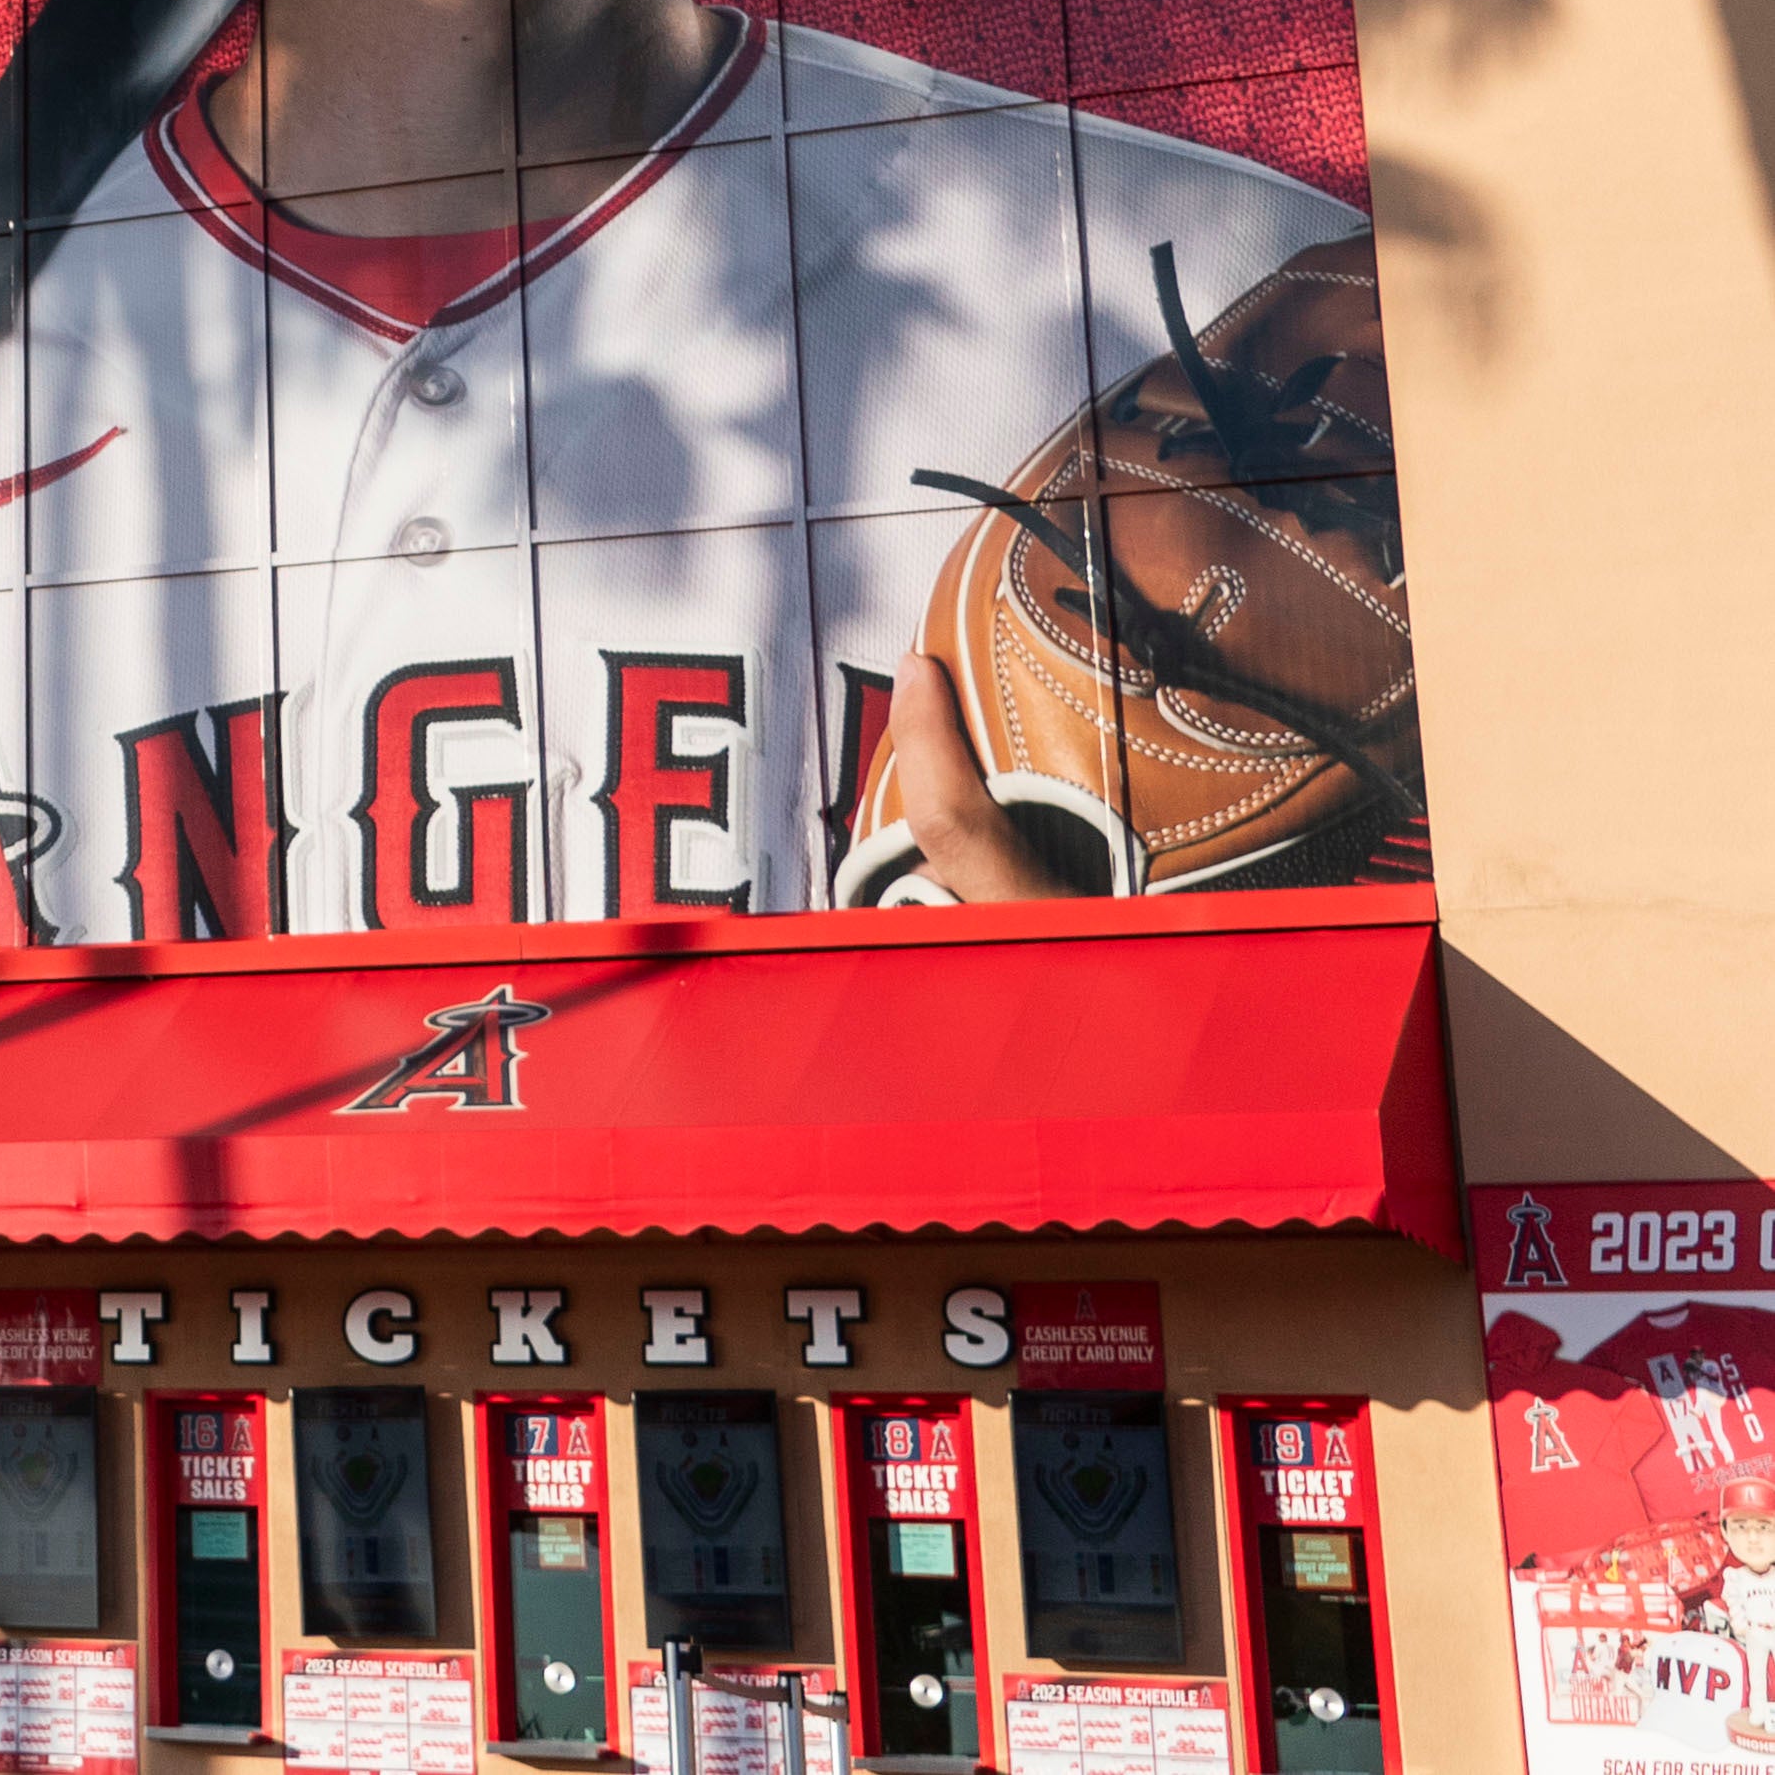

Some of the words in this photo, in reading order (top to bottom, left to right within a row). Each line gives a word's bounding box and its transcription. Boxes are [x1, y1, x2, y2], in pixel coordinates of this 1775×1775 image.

[332, 983, 553, 1114] A
[1503, 1191, 1568, 1286] A
[1590, 1210, 1736, 1273] 2023
[53, 1327, 90, 1343] VENUE
[98, 1286, 1013, 1369] TICKETS
[1025, 1325, 1096, 1342] CASHLESS
[1099, 1325, 1149, 1342] VENUE
[32, 1344, 64, 1360] CARD
[65, 1344, 95, 1360] ONLY
[1021, 1344, 1073, 1362] CREDIT
[1076, 1344, 1115, 1362] CARD
[1117, 1344, 1155, 1362] ONLY
[180, 1414, 219, 1450] 16
[514, 1417, 550, 1454] 17
[871, 1420, 912, 1459] 18
[1259, 1424, 1305, 1464] 19
[1524, 1396, 1580, 1472] A
[179, 1456, 256, 1479] TICKET
[512, 1459, 593, 1484] TICKET
[871, 1464, 958, 1491] TICKET
[190, 1479, 247, 1501] SALES
[524, 1483, 585, 1508] SALES
[1260, 1469, 1354, 1497] TICKET
[886, 1489, 950, 1515] SALES
[1276, 1495, 1347, 1522] SALES
[9, 1647, 53, 1664] SEASON
[54, 1649, 114, 1665] SCHEDULE
[305, 1658, 335, 1674] 2023
[335, 1658, 383, 1676] SEASON
[384, 1661, 448, 1678] SCHEDULE
[1031, 1683, 1065, 1701] 2023
[1067, 1685, 1122, 1704] SEASON
[1124, 1687, 1199, 1707] SCHEDULE
[1603, 1759, 1647, 1775] SCAN
[1653, 1760, 1684, 1775] FOR
